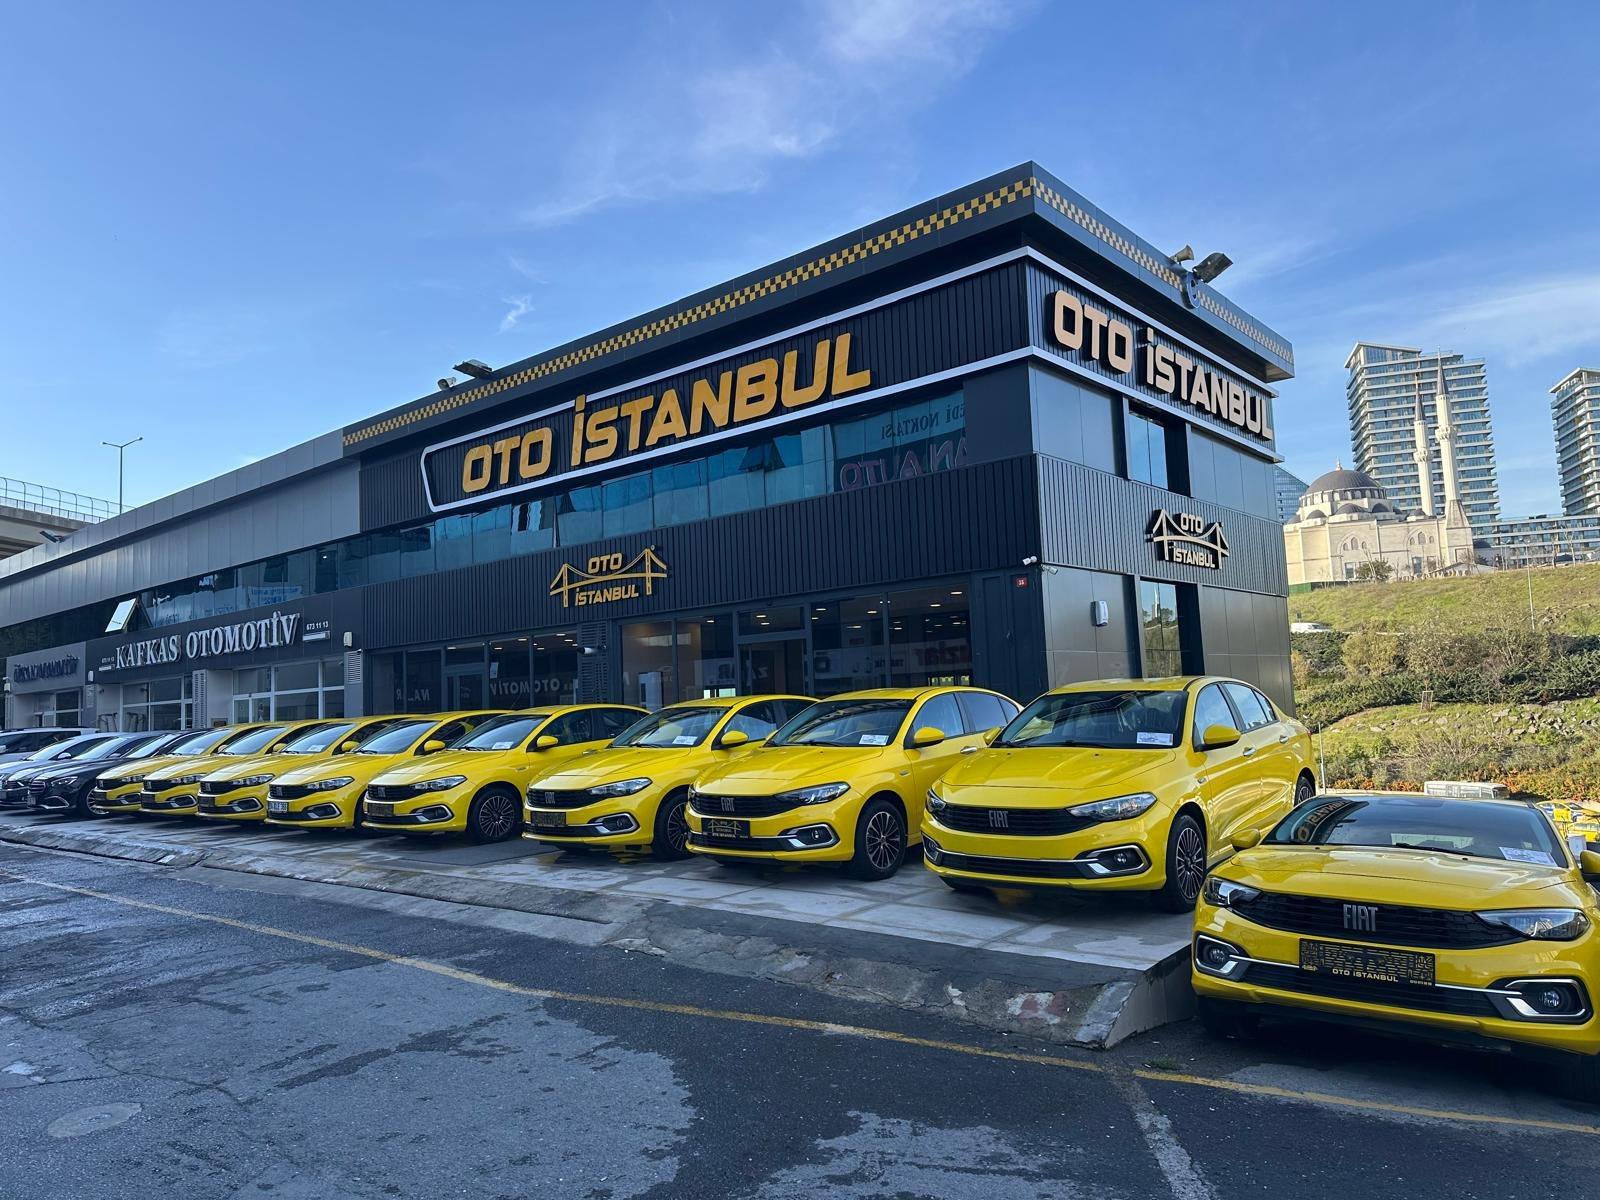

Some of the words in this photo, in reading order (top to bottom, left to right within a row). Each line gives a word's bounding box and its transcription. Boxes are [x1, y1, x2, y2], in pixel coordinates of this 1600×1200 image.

[1054, 289, 1133, 374] OTO
[1146, 327, 1273, 441] İSTANBUL
[462, 427, 553, 493] OTO
[570, 332, 871, 467] İSTANBUL
[1180, 512, 1204, 534] OTO
[587, 552, 623, 574] OTO
[575, 584, 639, 606] İSTANBUL
[115, 634, 181, 669] KAFKAS
[185, 610, 300, 658] OTOMOTİV
[988, 810, 1009, 828] FIAT
[1343, 903, 1379, 932] FIAT
[1332, 968, 1350, 976] OTO
